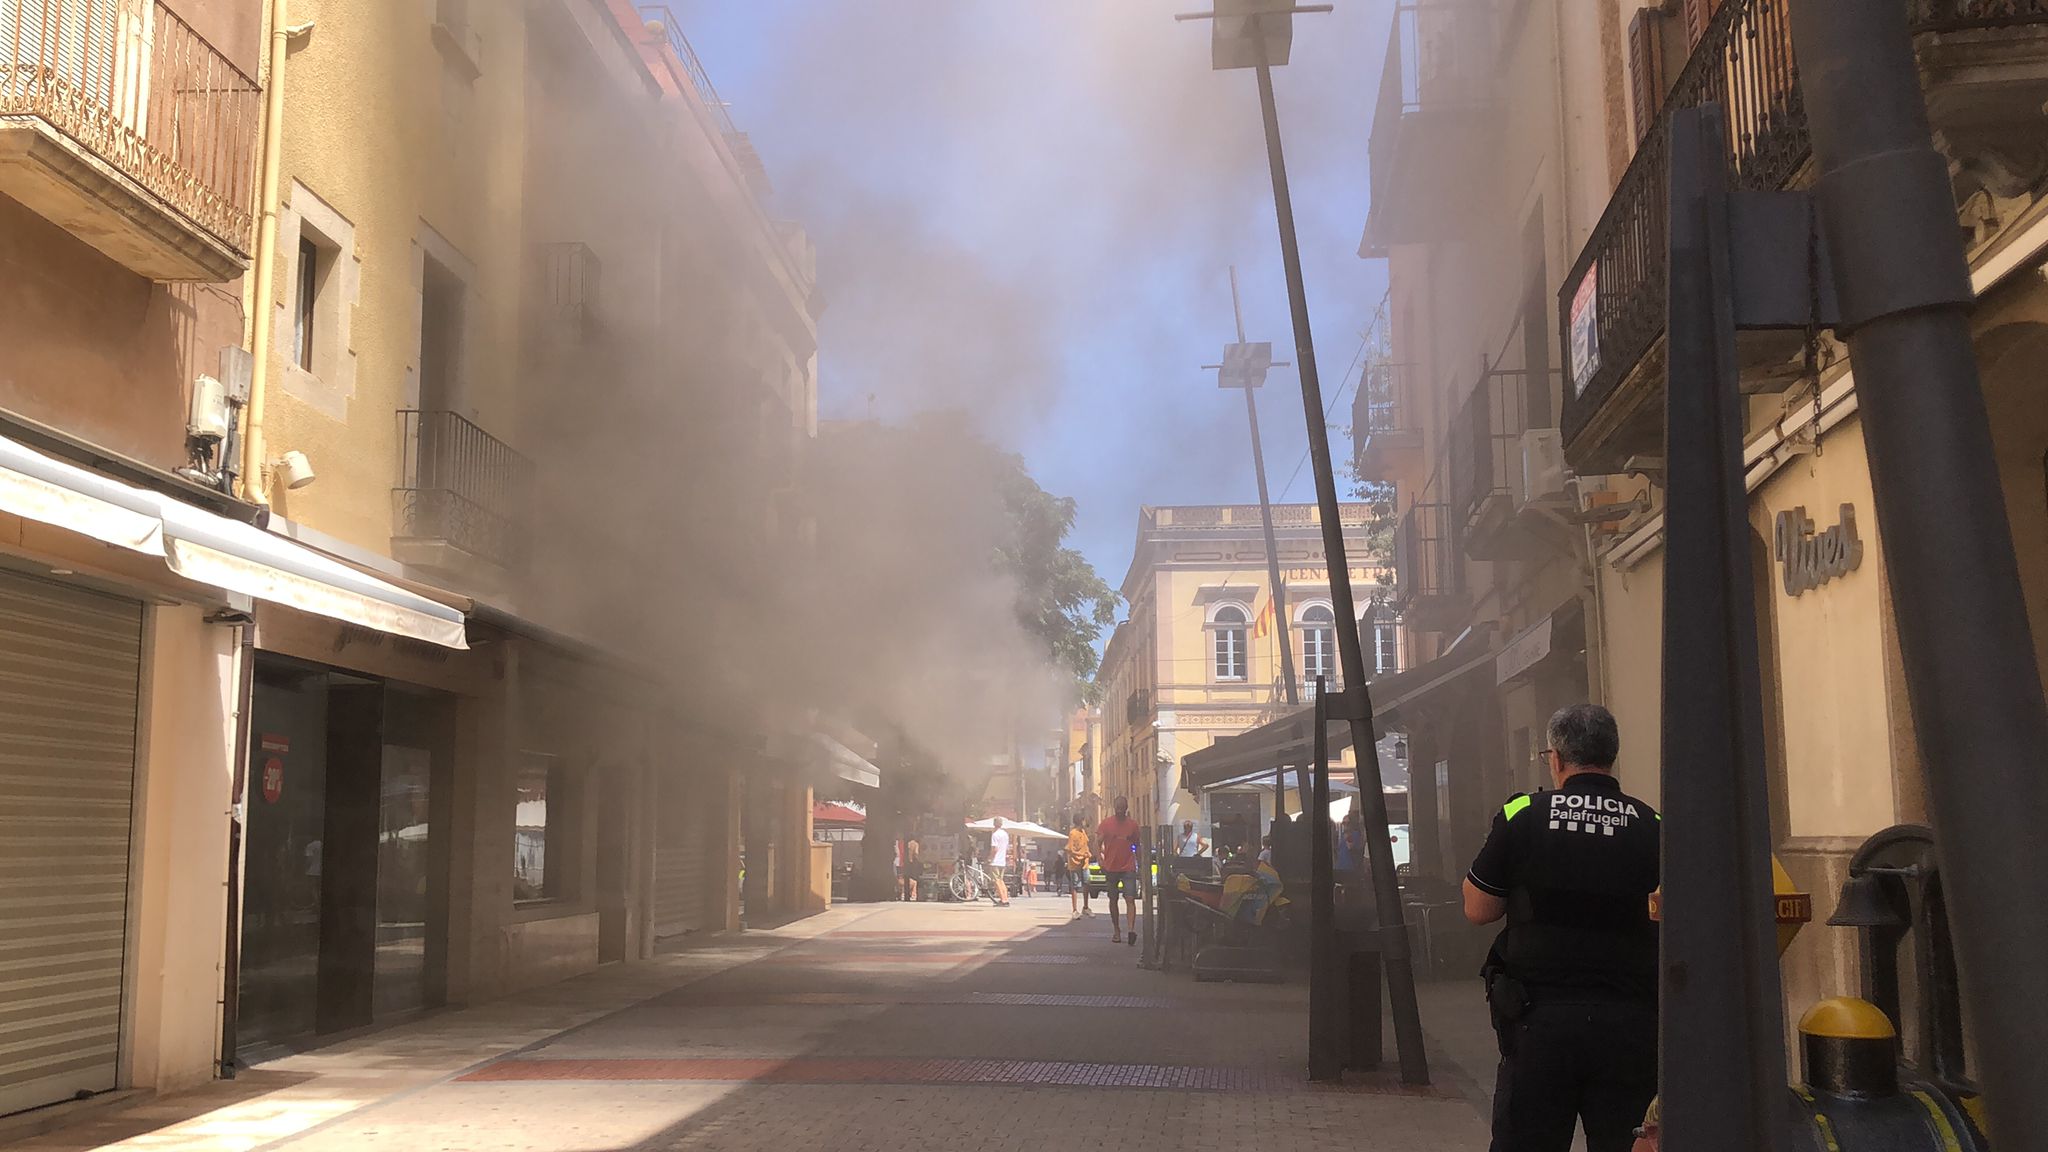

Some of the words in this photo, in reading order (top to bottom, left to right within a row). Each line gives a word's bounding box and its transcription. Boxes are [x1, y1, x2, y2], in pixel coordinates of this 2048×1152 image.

[1289, 567, 1356, 580] CENE
[1551, 795, 1640, 819] POLICIA
[1550, 809, 1628, 827] Palafrugell
